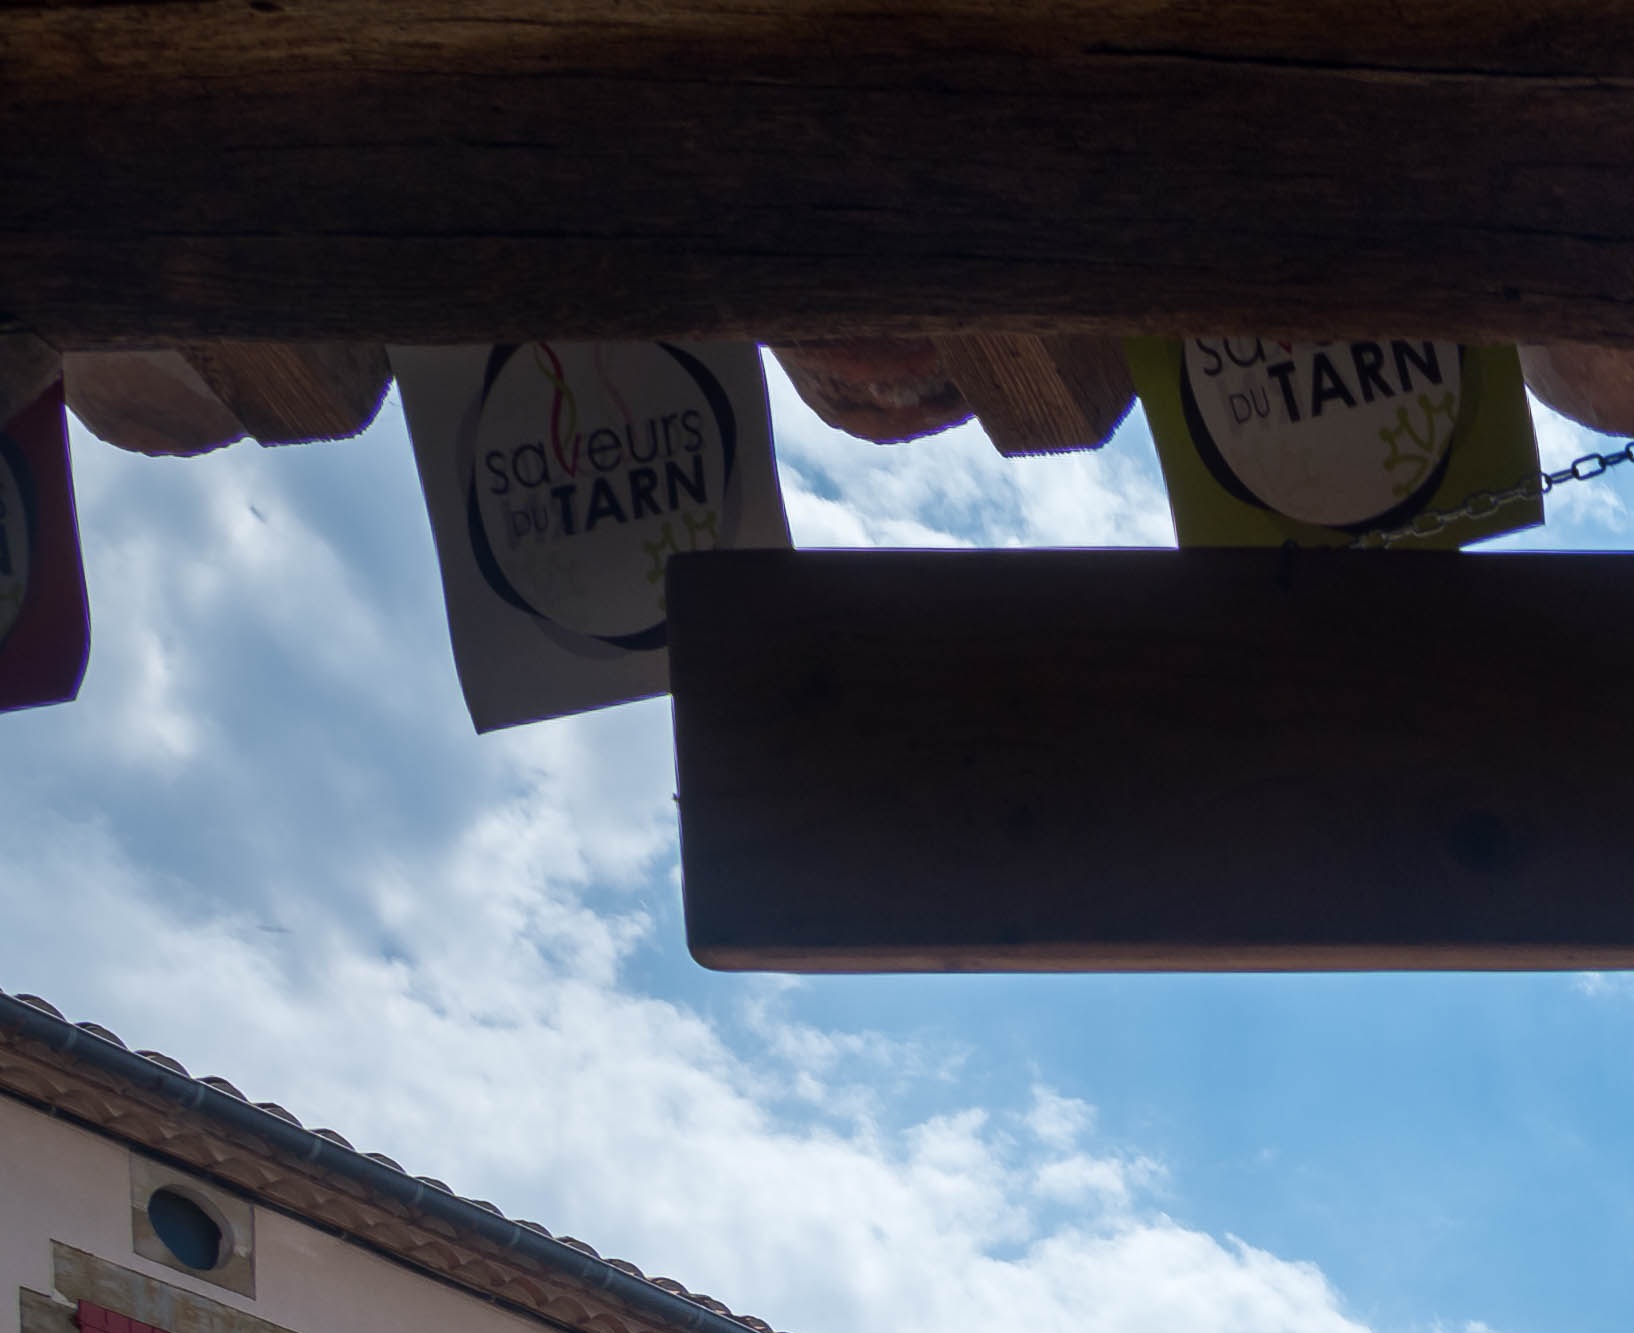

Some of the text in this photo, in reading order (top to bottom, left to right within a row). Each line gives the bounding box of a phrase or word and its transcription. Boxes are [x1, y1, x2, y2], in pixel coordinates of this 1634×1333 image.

[1229, 386, 1271, 425] DU
[1267, 339, 1443, 423] TARN
[509, 453, 708, 539] DU TARN
